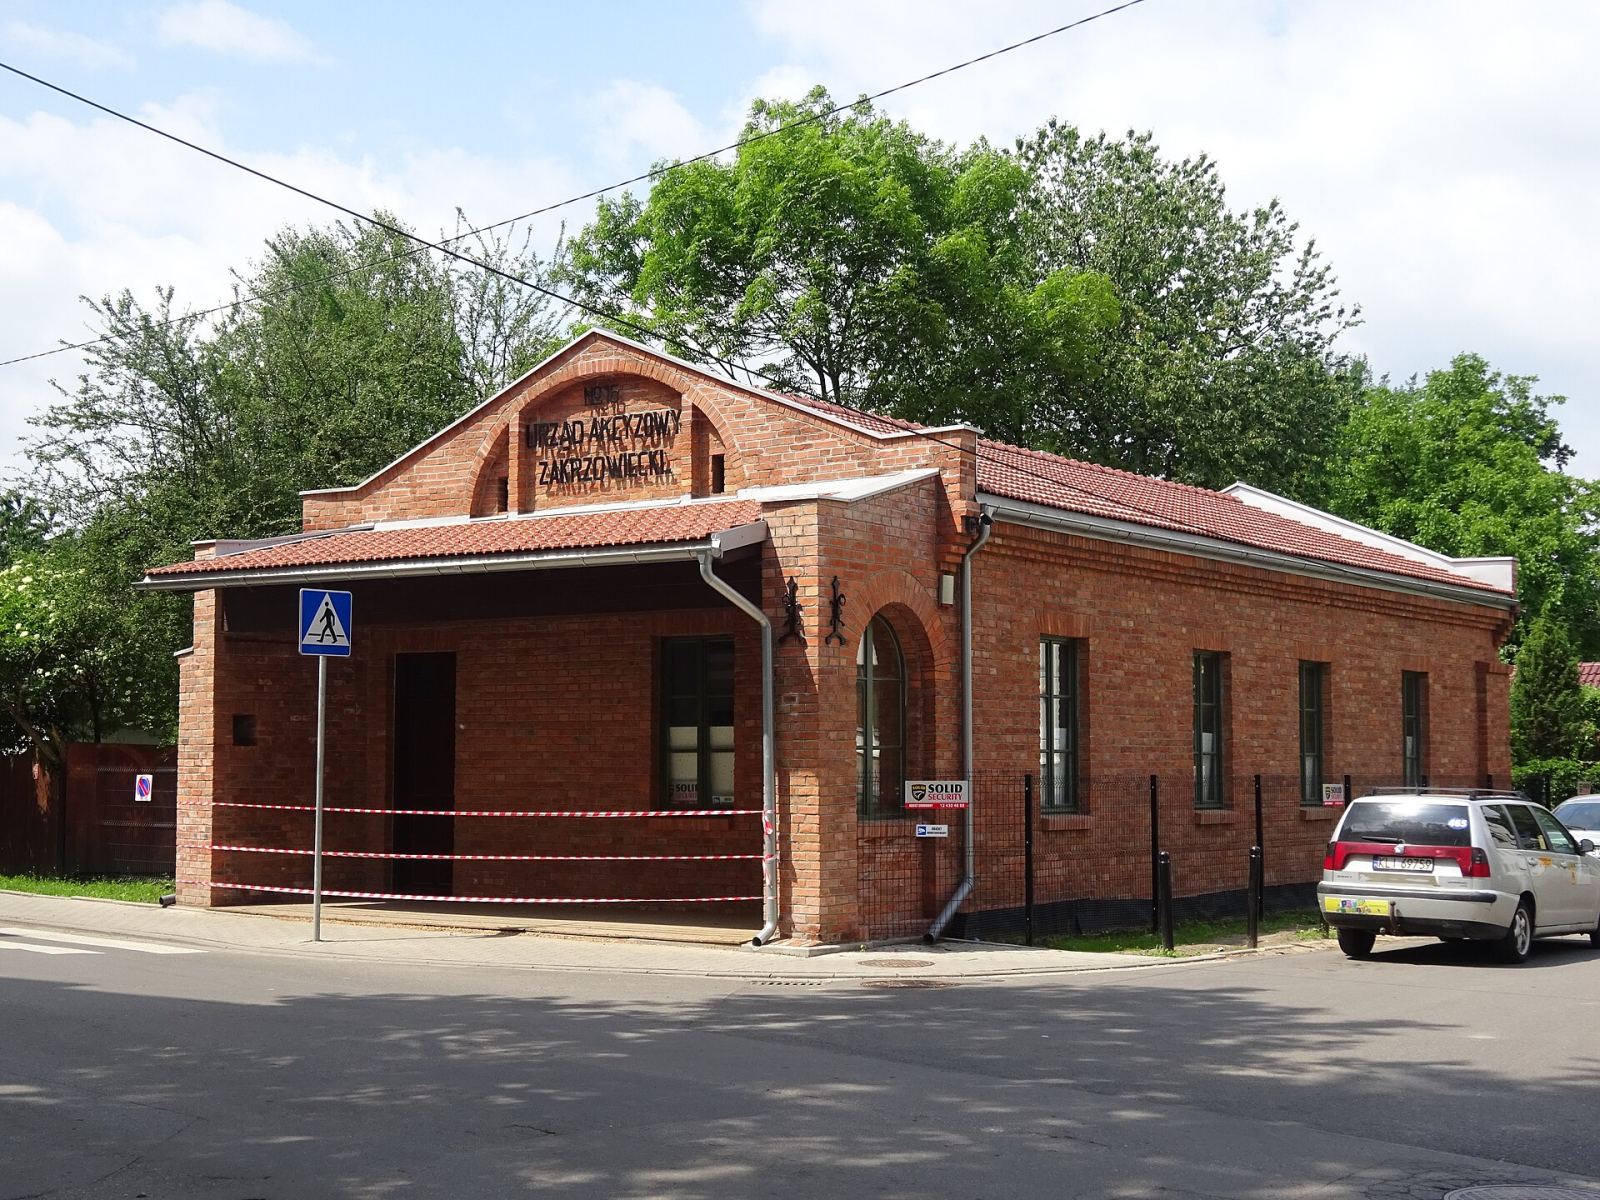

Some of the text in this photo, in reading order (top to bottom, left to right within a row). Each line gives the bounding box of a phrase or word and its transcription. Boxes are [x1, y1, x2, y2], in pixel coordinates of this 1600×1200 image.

[589, 408, 682, 441] AKCYZOWY
[928, 784, 963, 793] SOLID
[1400, 858, 1432, 870] 69759
